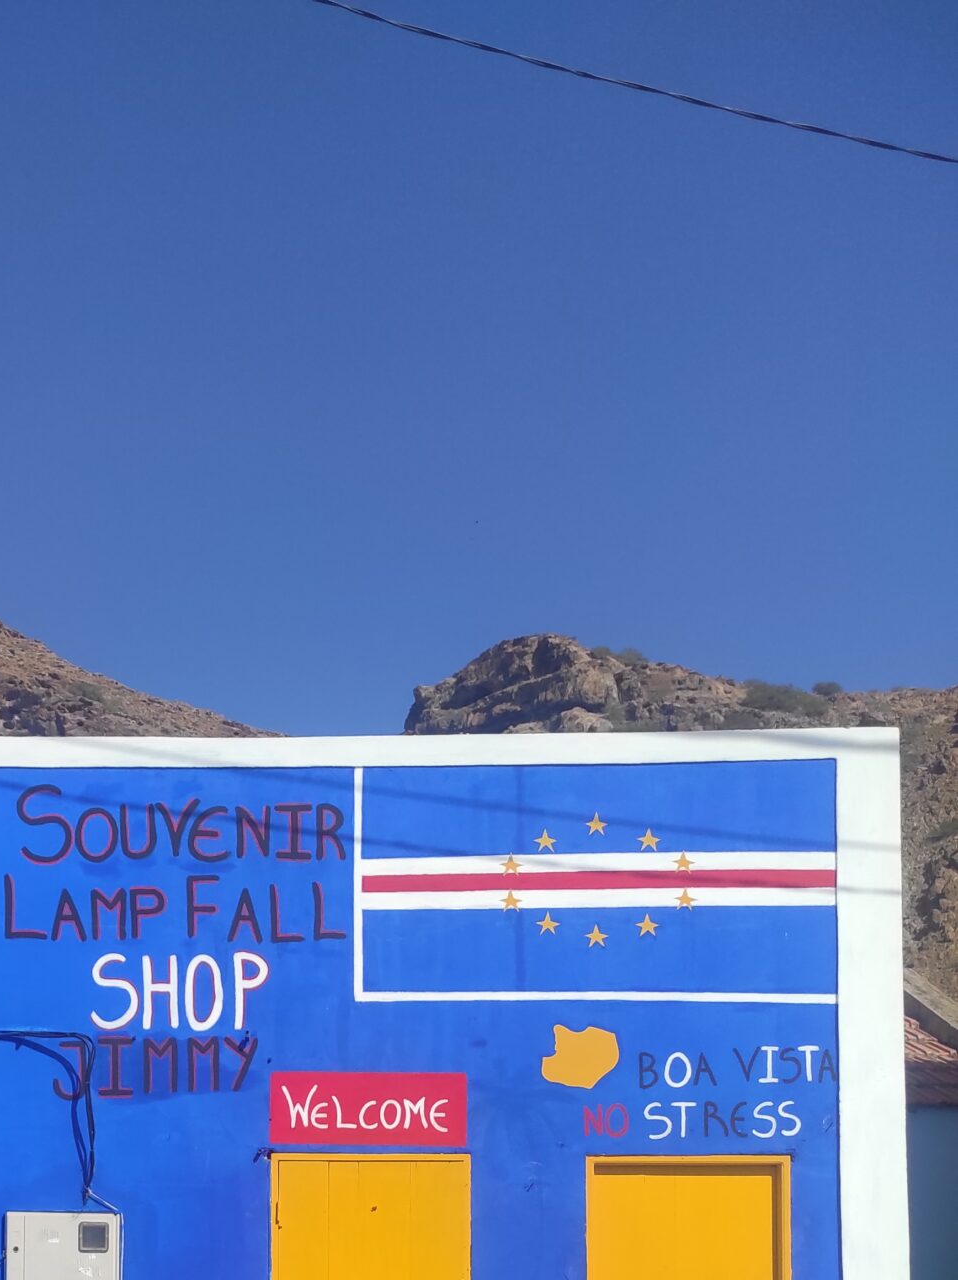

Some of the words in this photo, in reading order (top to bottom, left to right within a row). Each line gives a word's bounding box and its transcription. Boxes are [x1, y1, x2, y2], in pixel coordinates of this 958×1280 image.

[16, 784, 346, 865] SOUVENIR
[4, 873, 167, 941] LAMP
[186, 875, 346, 943] FALL
[90, 951, 269, 1031] SHOP
[52, 1035, 259, 1101] JIMMY
[638, 1051, 718, 1090] BOA
[732, 1045, 838, 1084] VISTA
[281, 1084, 449, 1133] WELCOME
[583, 1103, 629, 1138] NO
[643, 1101, 802, 1140] STRESS
